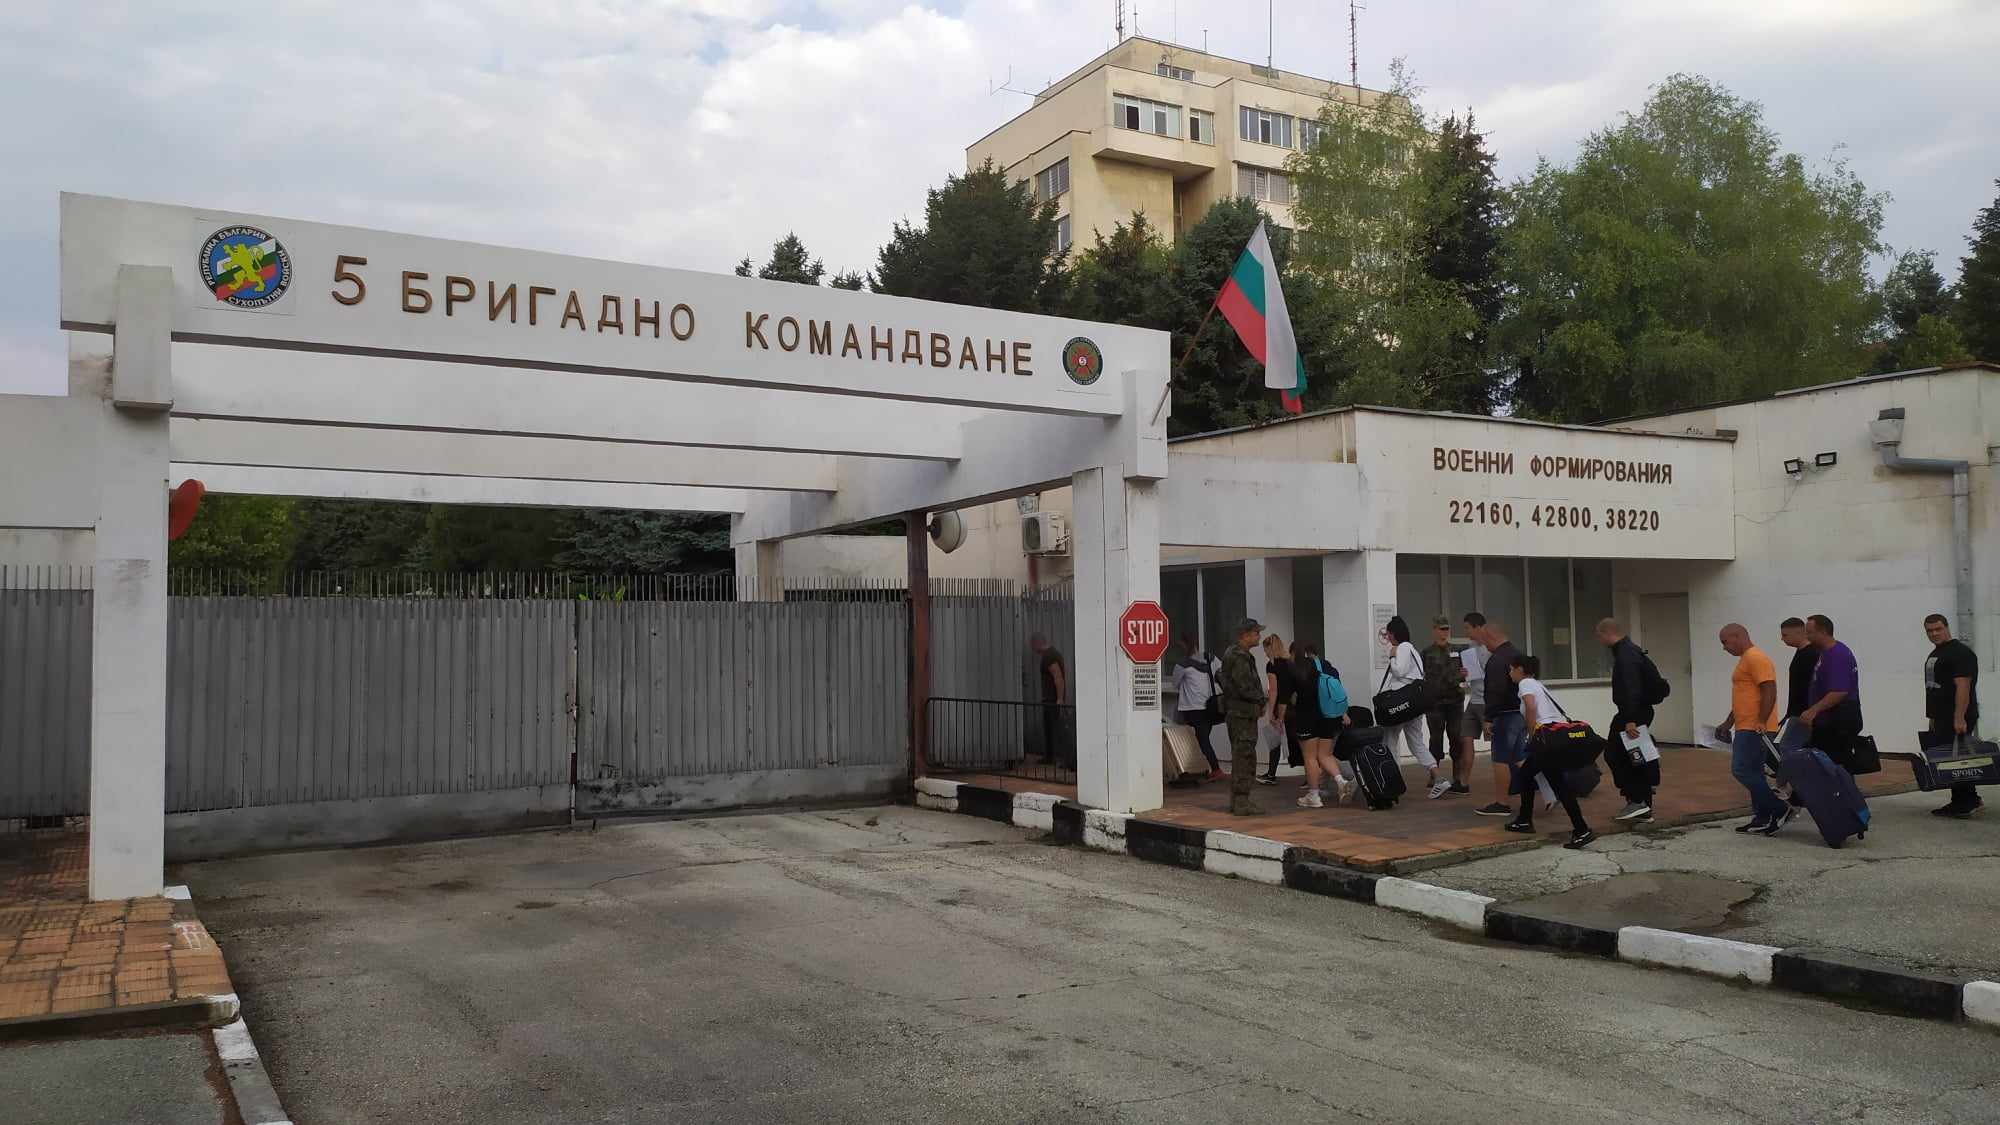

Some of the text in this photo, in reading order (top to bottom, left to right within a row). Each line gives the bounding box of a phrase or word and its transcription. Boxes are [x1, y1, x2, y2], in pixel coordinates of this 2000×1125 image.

[218, 228, 266, 241] БЪЛГАРИЯ
[331, 254, 1033, 376] 5 БРИГАДНО КОМАНДВАНЕ
[1433, 447, 1672, 485] ВОЕННИ ФОРМИРОВАНИЯ
[1449, 500, 1659, 532] 22160, 42800, 38220
[1127, 620, 1164, 645] STOP
[1388, 702, 1410, 715] SPORT
[1951, 768, 1984, 778] SPORTS
